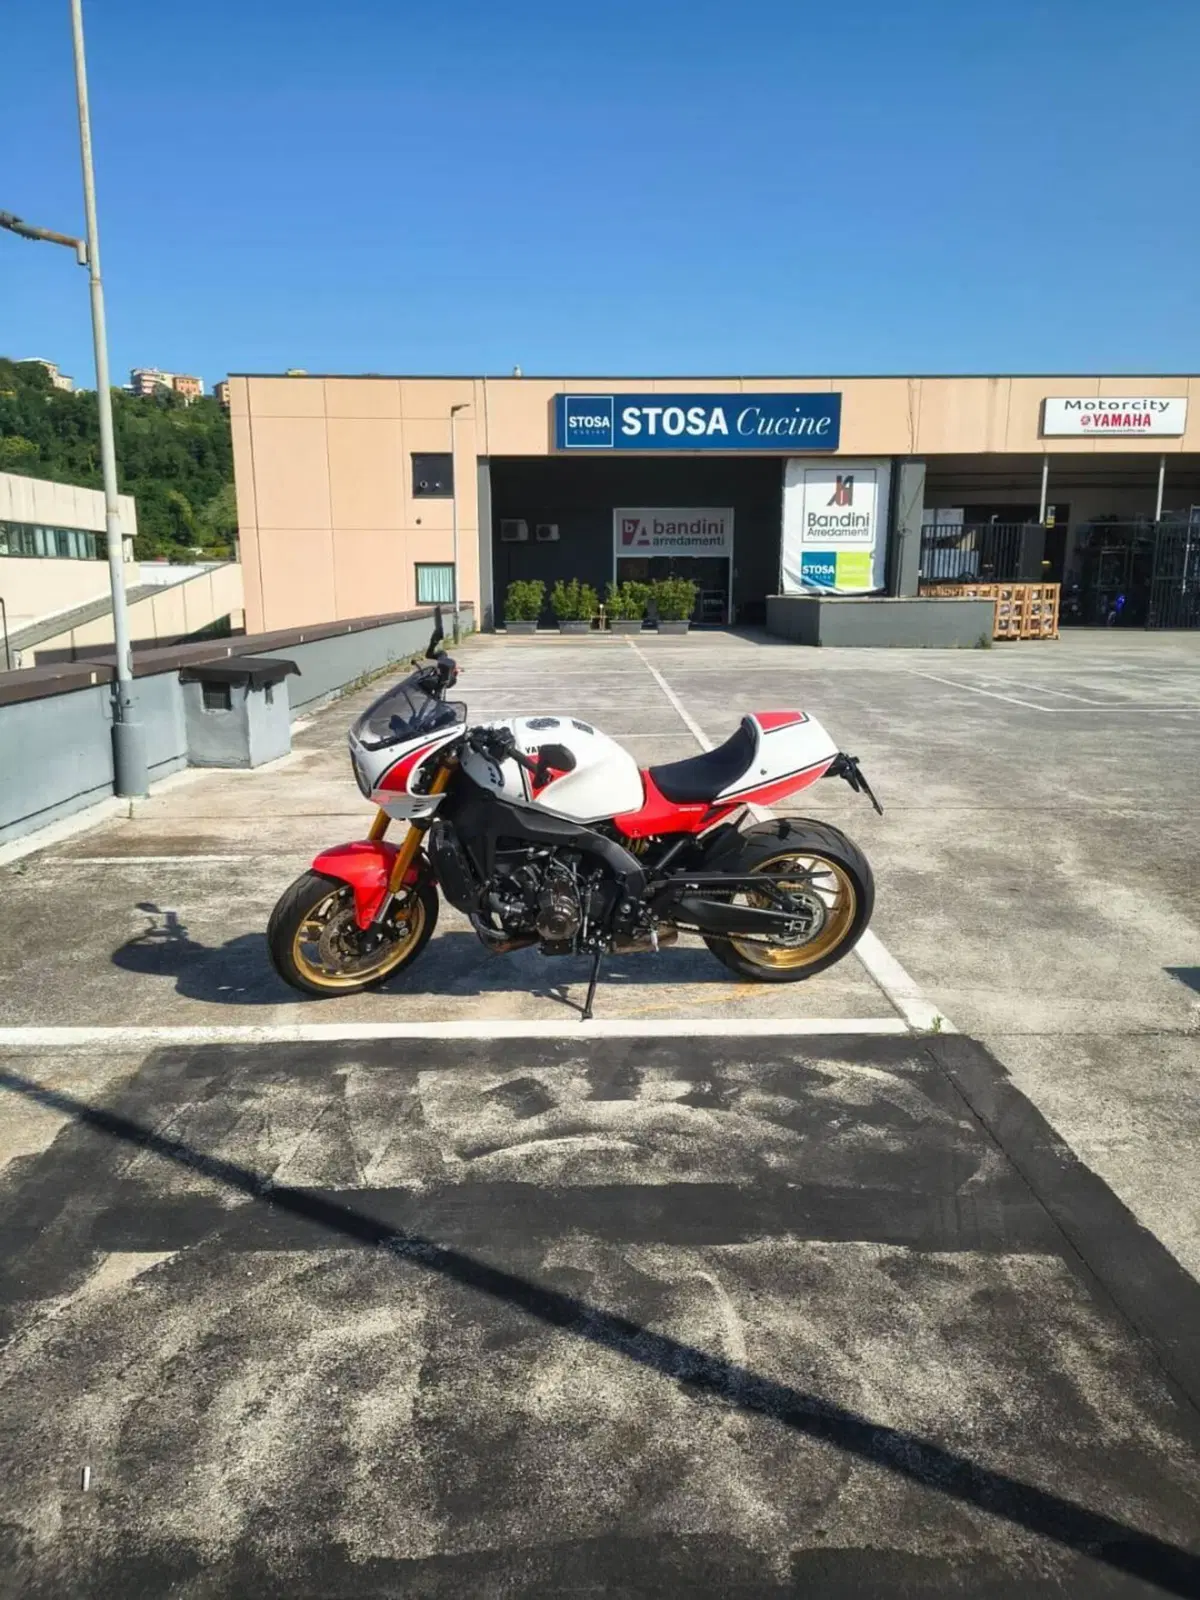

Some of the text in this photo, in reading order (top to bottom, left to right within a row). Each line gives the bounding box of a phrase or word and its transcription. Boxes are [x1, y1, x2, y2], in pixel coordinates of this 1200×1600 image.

[1064, 400, 1170, 413] Motorcity
[569, 415, 610, 428] STOSA
[621, 406, 832, 436] STOSA Cucine
[1092, 413, 1152, 427] YAMAHA
[807, 512, 870, 527] Bandini
[652, 518, 724, 535] bandini
[807, 527, 869, 537] Arredamenti
[652, 535, 725, 546] arredamenti
[802, 564, 835, 575] STOSA
